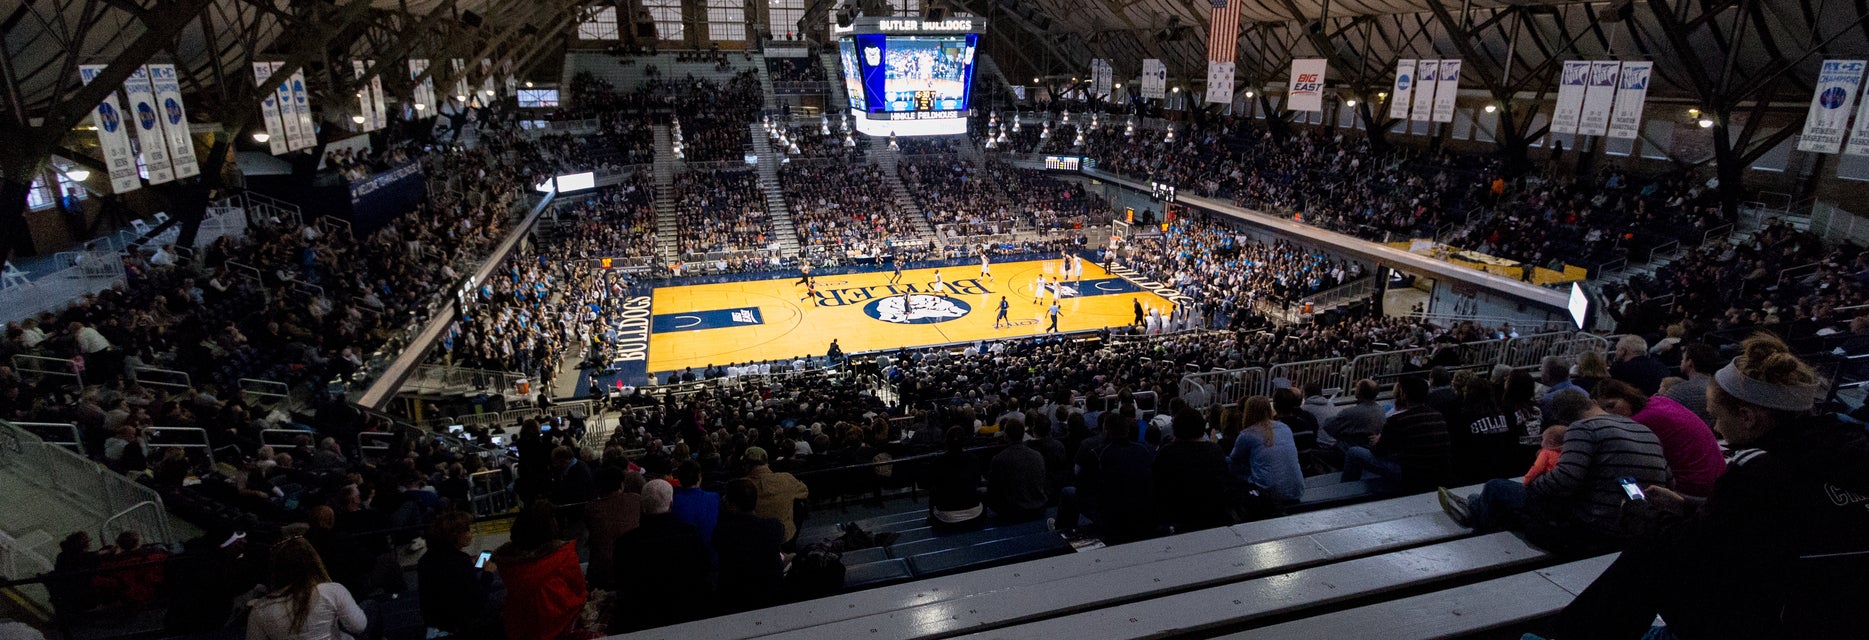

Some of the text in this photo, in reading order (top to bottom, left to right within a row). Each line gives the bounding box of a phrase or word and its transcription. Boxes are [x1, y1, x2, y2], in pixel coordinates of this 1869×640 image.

[879, 20, 972, 31] BUTLER BULLDOGS
[1297, 74, 1318, 83] BIG
[1293, 83, 1323, 91] EAST
[890, 111, 958, 121] HINKLE FIELDHOUSE
[816, 278, 995, 306] BUTLER
[613, 295, 652, 362] BULLDOGS
